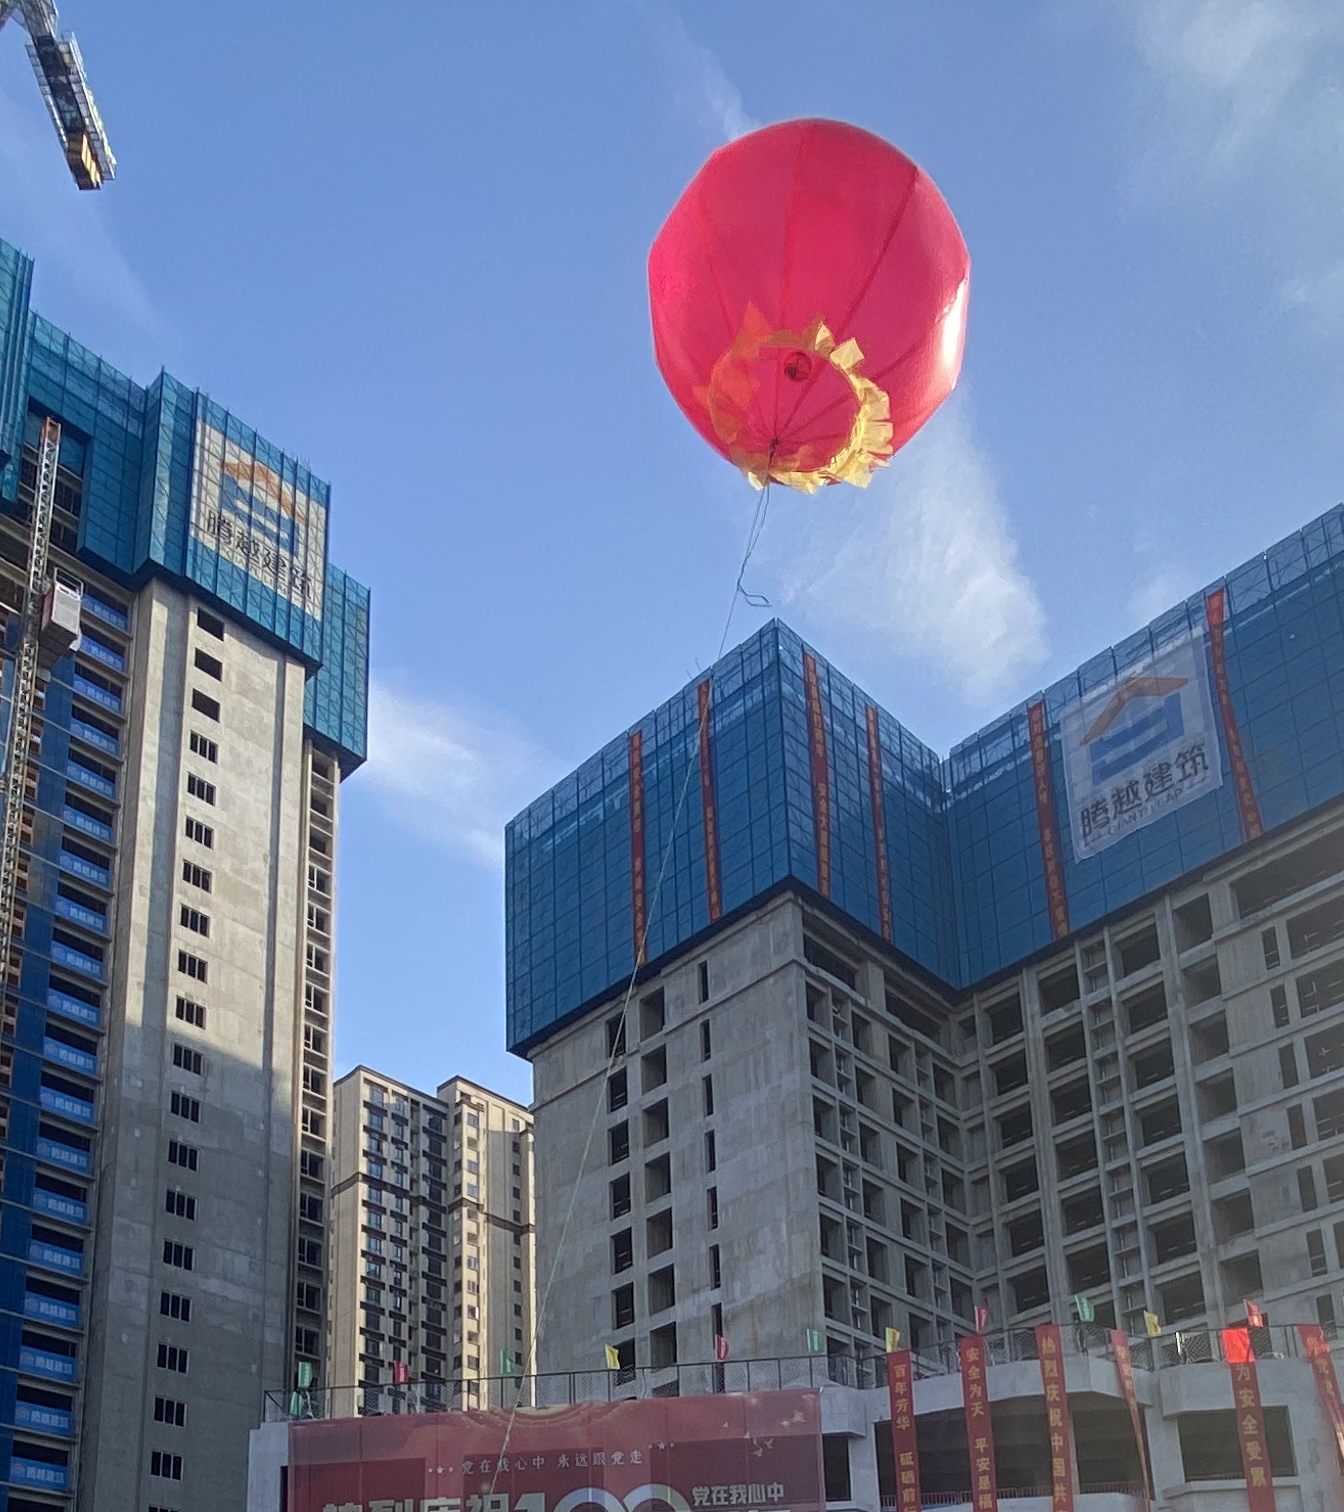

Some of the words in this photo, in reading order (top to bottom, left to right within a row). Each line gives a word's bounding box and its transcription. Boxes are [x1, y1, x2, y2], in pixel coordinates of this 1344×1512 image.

[207, 508, 312, 600] 腾越建筑
[1080, 742, 1209, 848] 腾越建筑
[892, 1363, 912, 1432] 百年芳华
[965, 1346, 986, 1419] 安全为天
[460, 1454, 546, 1475] 党在我心中
[556, 1449, 644, 1469] 永远跟党走
[691, 1482, 785, 1506] 党在我心中
[973, 1436, 994, 1511] 平安是福
